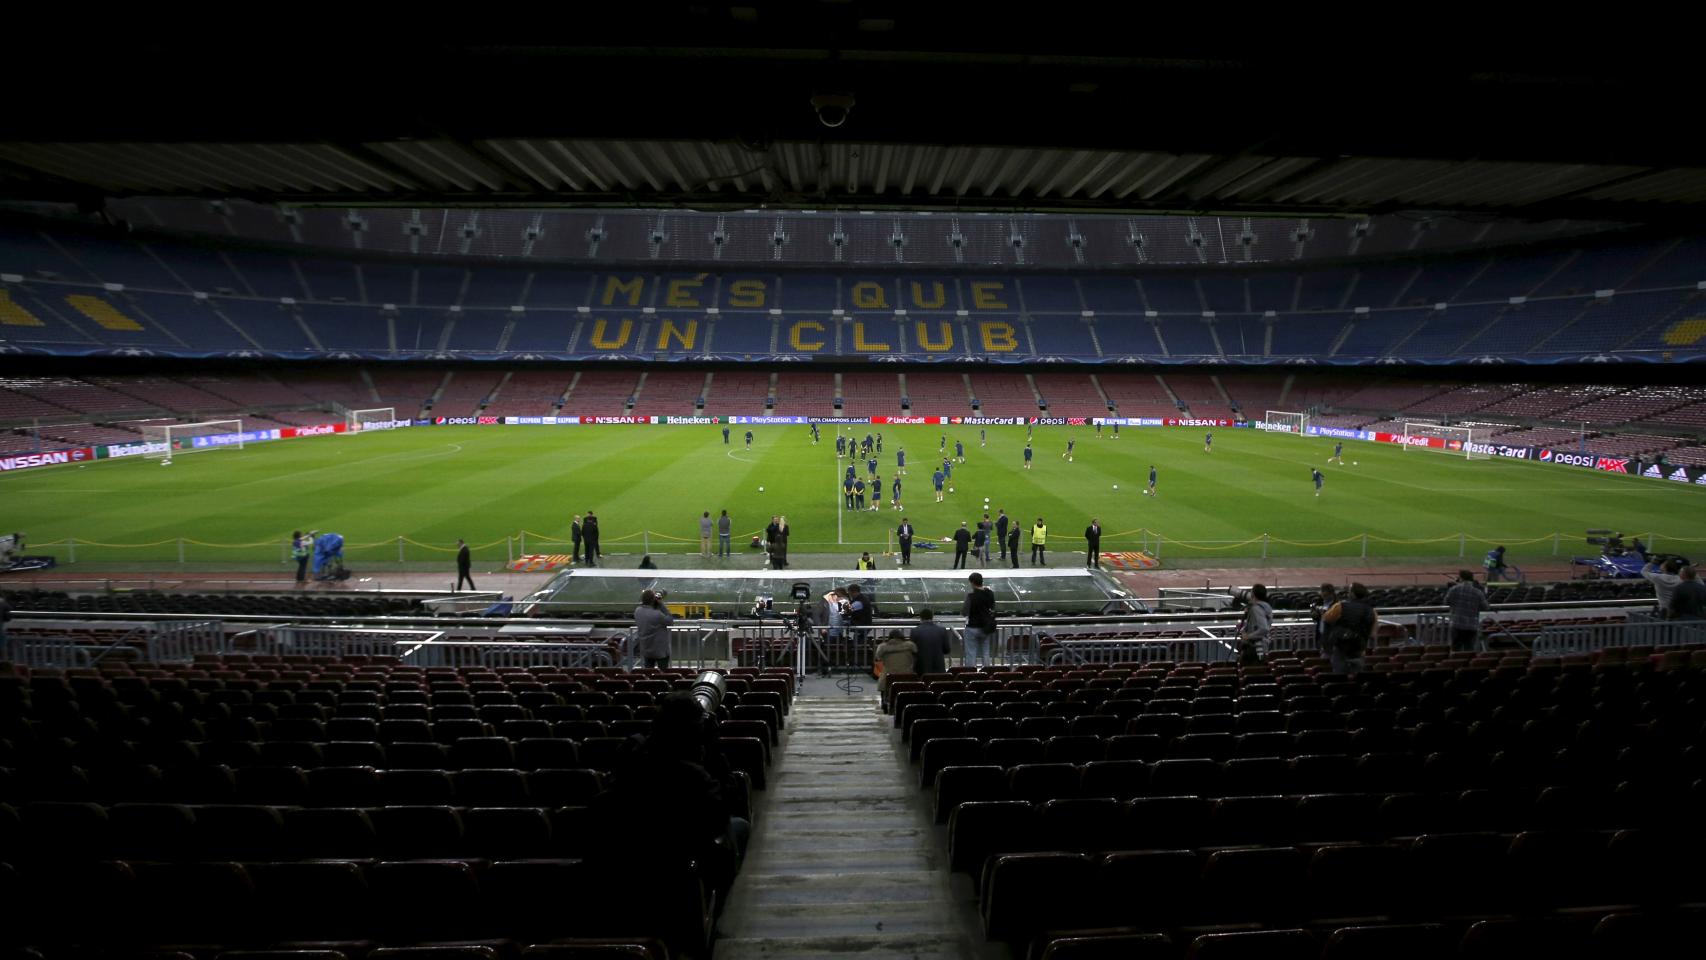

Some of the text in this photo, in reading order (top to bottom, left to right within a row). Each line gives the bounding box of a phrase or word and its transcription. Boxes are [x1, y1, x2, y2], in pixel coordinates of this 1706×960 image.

[605, 273, 1007, 310] MÉS QUE
[590, 318, 1019, 353] UN CLUB
[362, 419, 411, 430] MasterCard
[448, 417, 476, 425] pepsi
[667, 416, 711, 424] Heineken
[751, 416, 792, 424] PlayStation
[893, 416, 925, 424] UniCredit
[964, 417, 1014, 425] MasterCard
[1040, 417, 1065, 426] pepsi
[1255, 420, 1292, 432] Heineken
[1319, 427, 1355, 438] PlayStation
[1397, 434, 1429, 447] UniCredit
[0, 451, 69, 471] NISSAN
[1554, 453, 1630, 474] pepsi MAX
